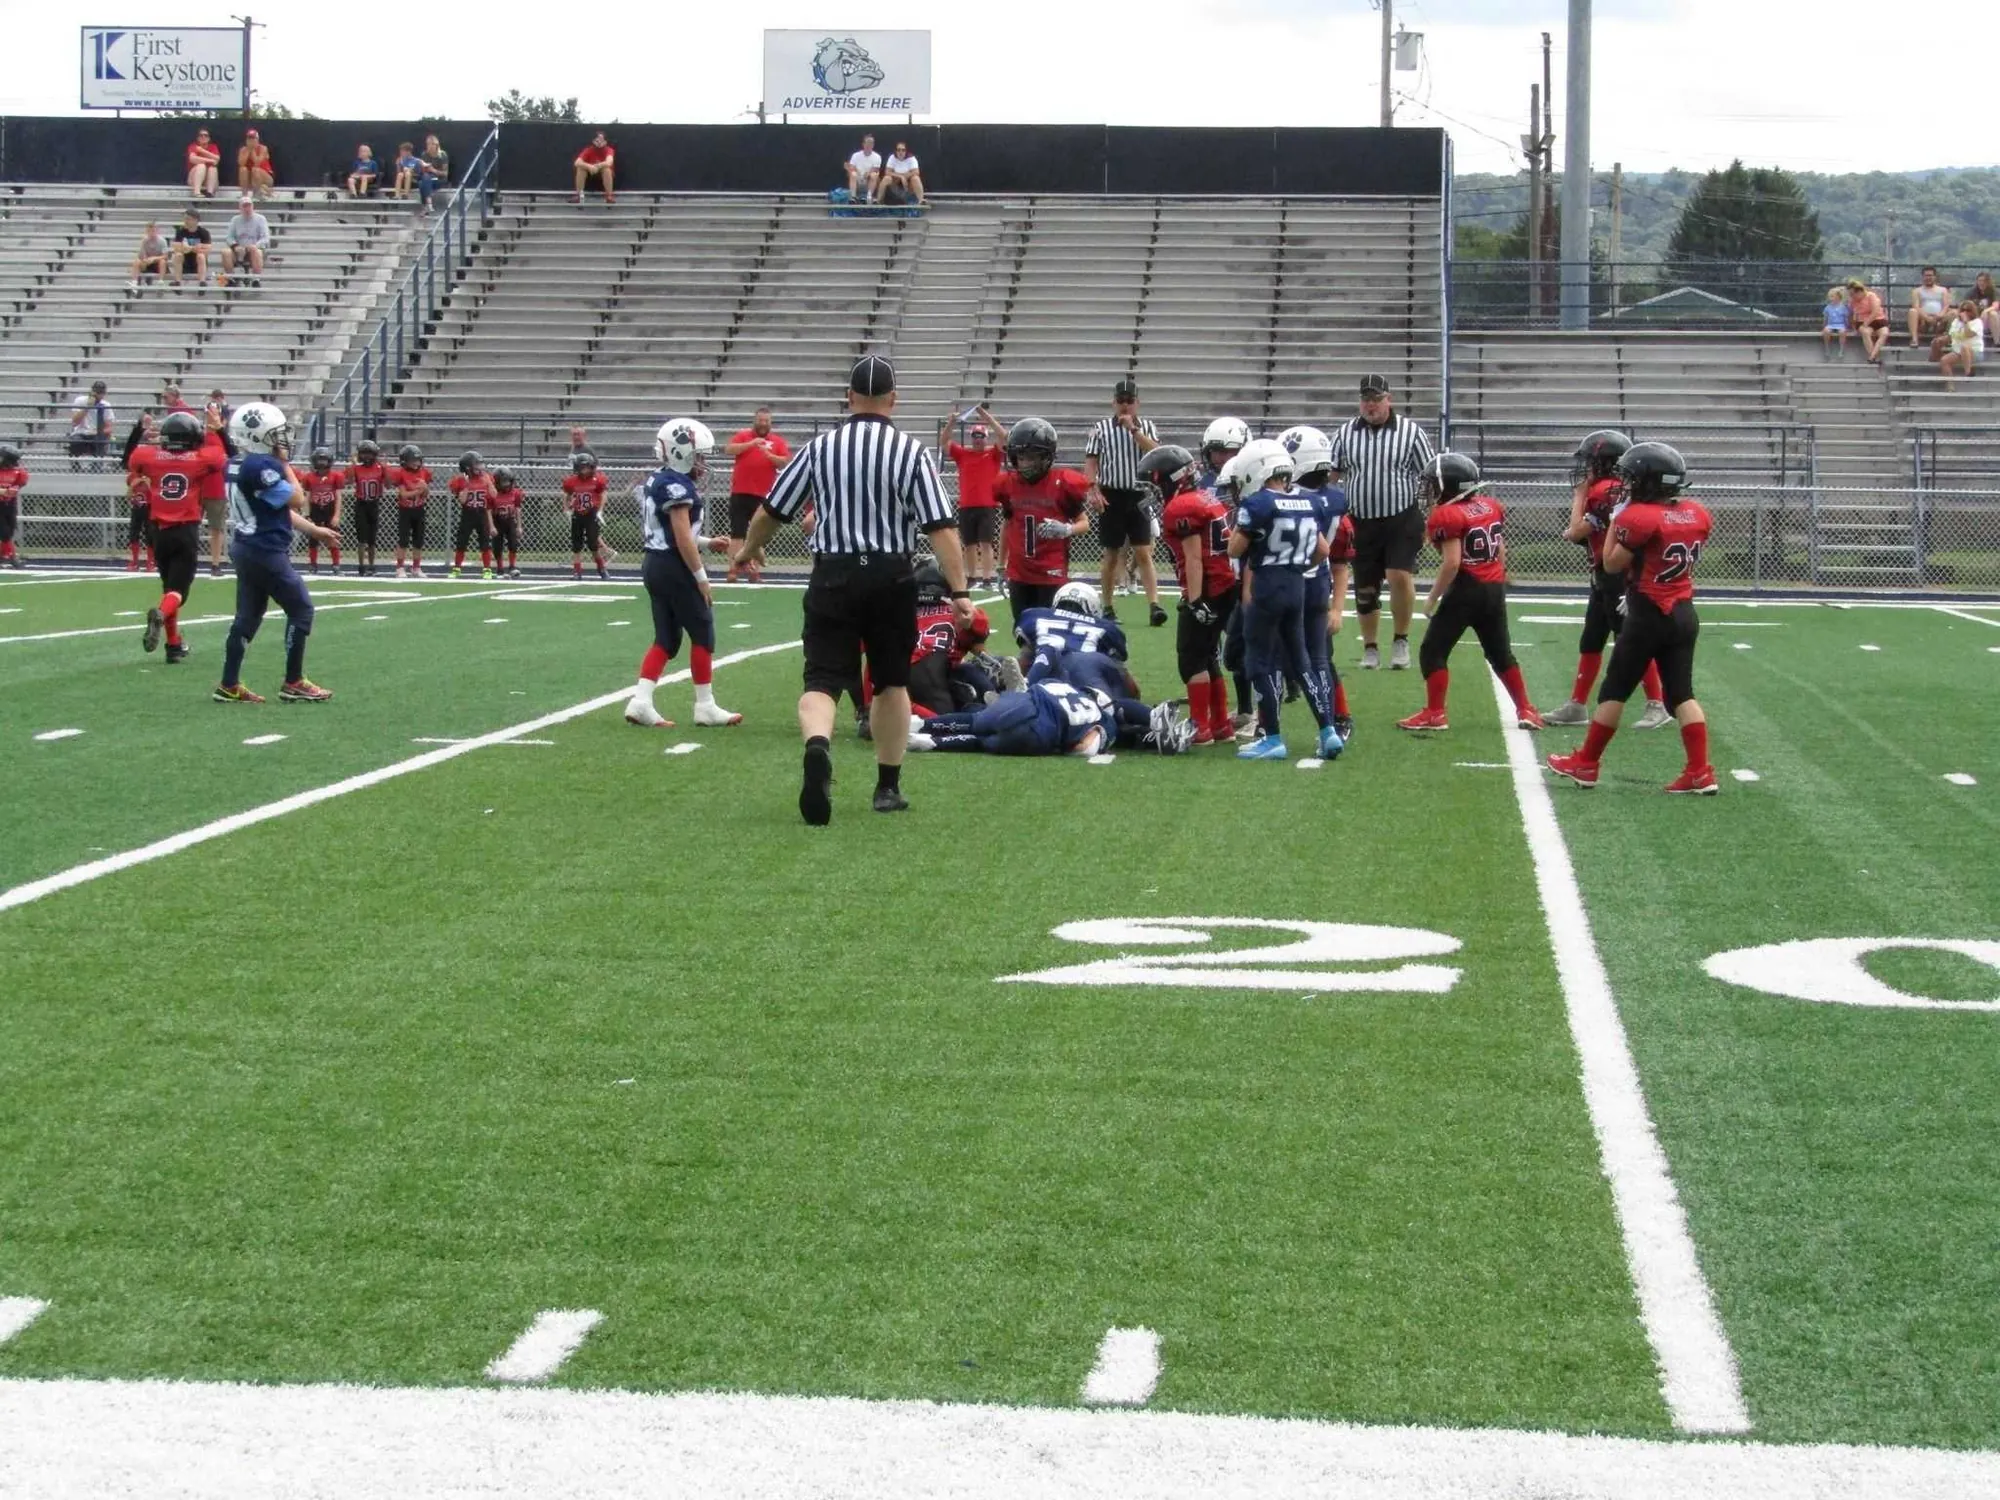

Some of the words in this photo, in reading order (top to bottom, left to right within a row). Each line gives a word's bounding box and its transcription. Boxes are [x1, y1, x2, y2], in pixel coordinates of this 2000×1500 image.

[132, 33, 183, 56] First
[132, 56, 236, 87] Keystone
[782, 97, 867, 109] ADVERTISE
[870, 97, 913, 109] HERE
[160, 472, 189, 501] 9
[1024, 514, 1036, 558] 1
[1261, 517, 1318, 567] 50
[859, 555, 868, 566] S
[1653, 541, 1701, 582] 21
[1036, 618, 1107, 653] 57
[995, 916, 1463, 993] 2
